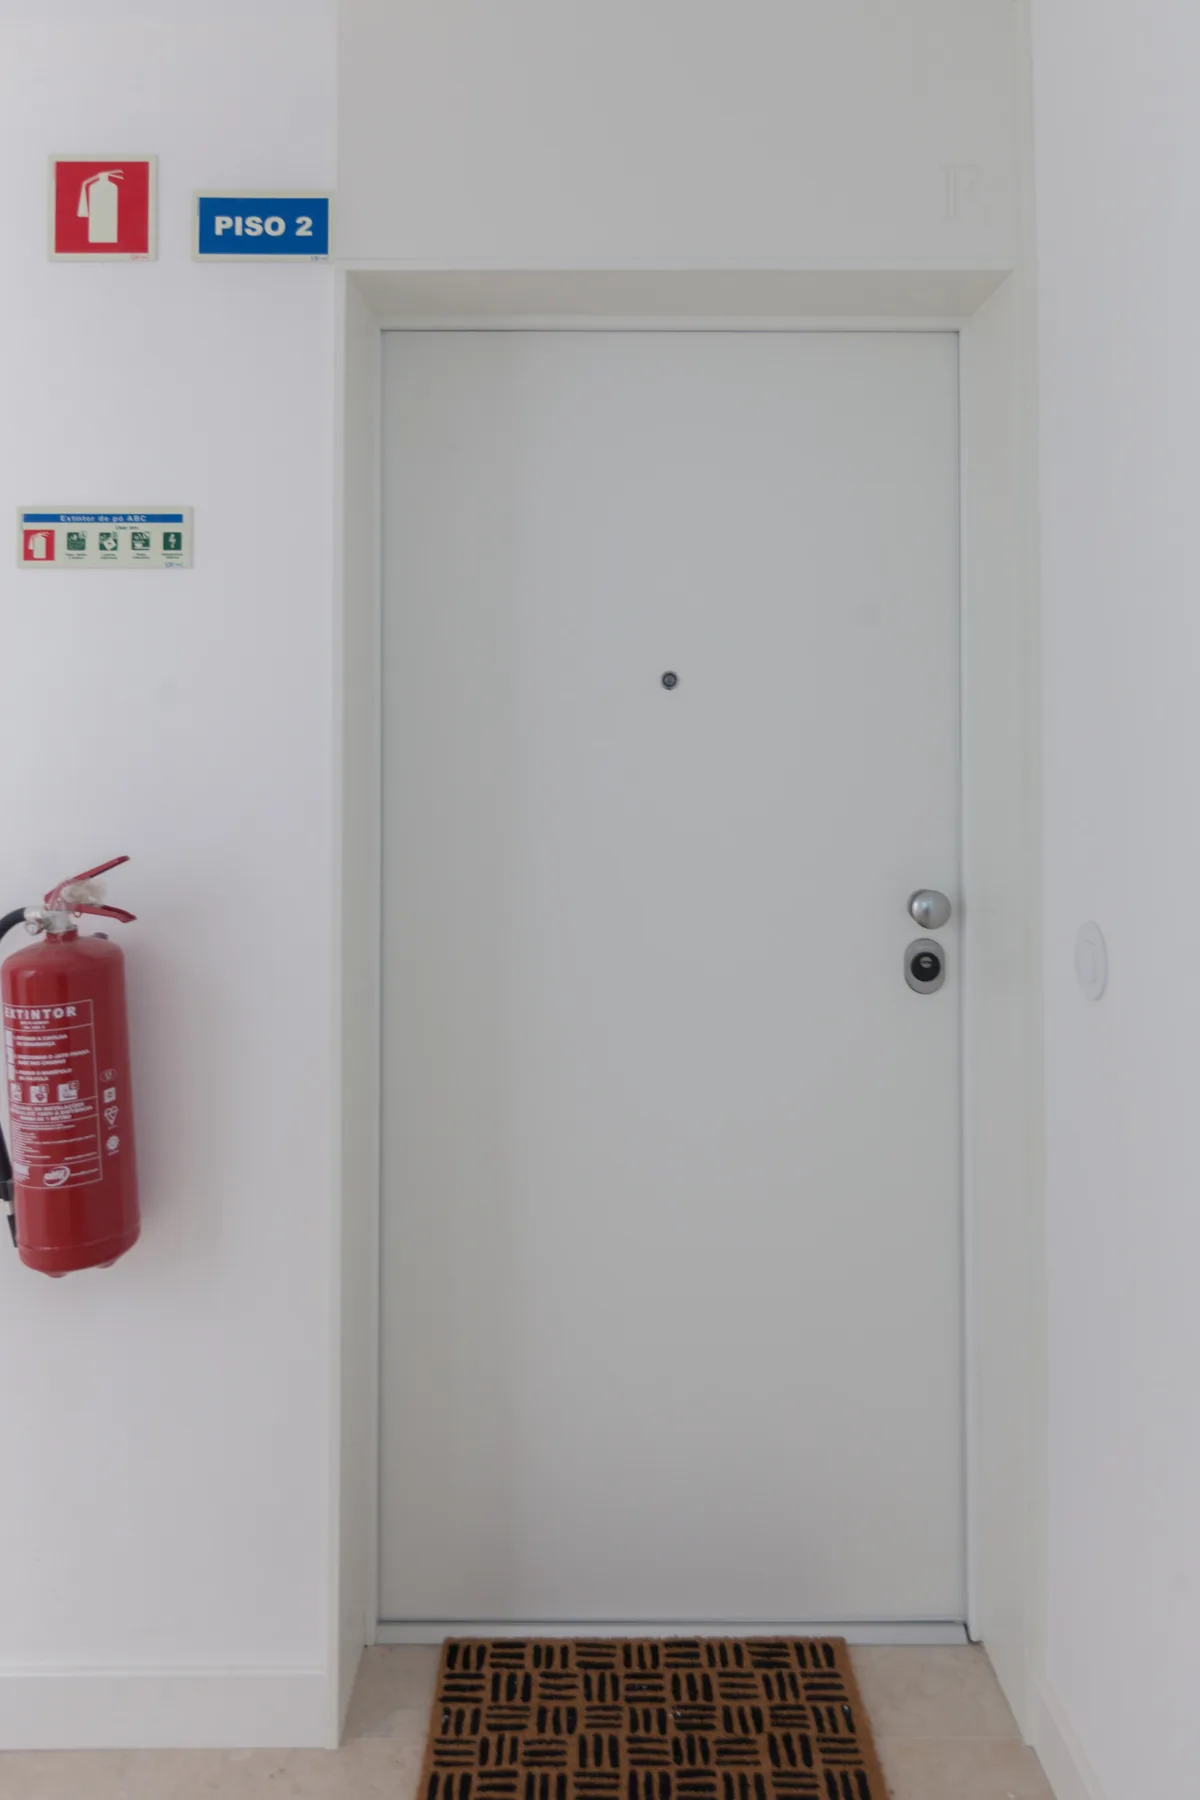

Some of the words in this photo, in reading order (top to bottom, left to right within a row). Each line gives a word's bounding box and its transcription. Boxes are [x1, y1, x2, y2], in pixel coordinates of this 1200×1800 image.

[214, 215, 286, 236] PISO
[295, 215, 313, 236] 2
[60, 514, 95, 522] Extintor
[98, 514, 110, 522] de
[127, 514, 147, 522] ABC
